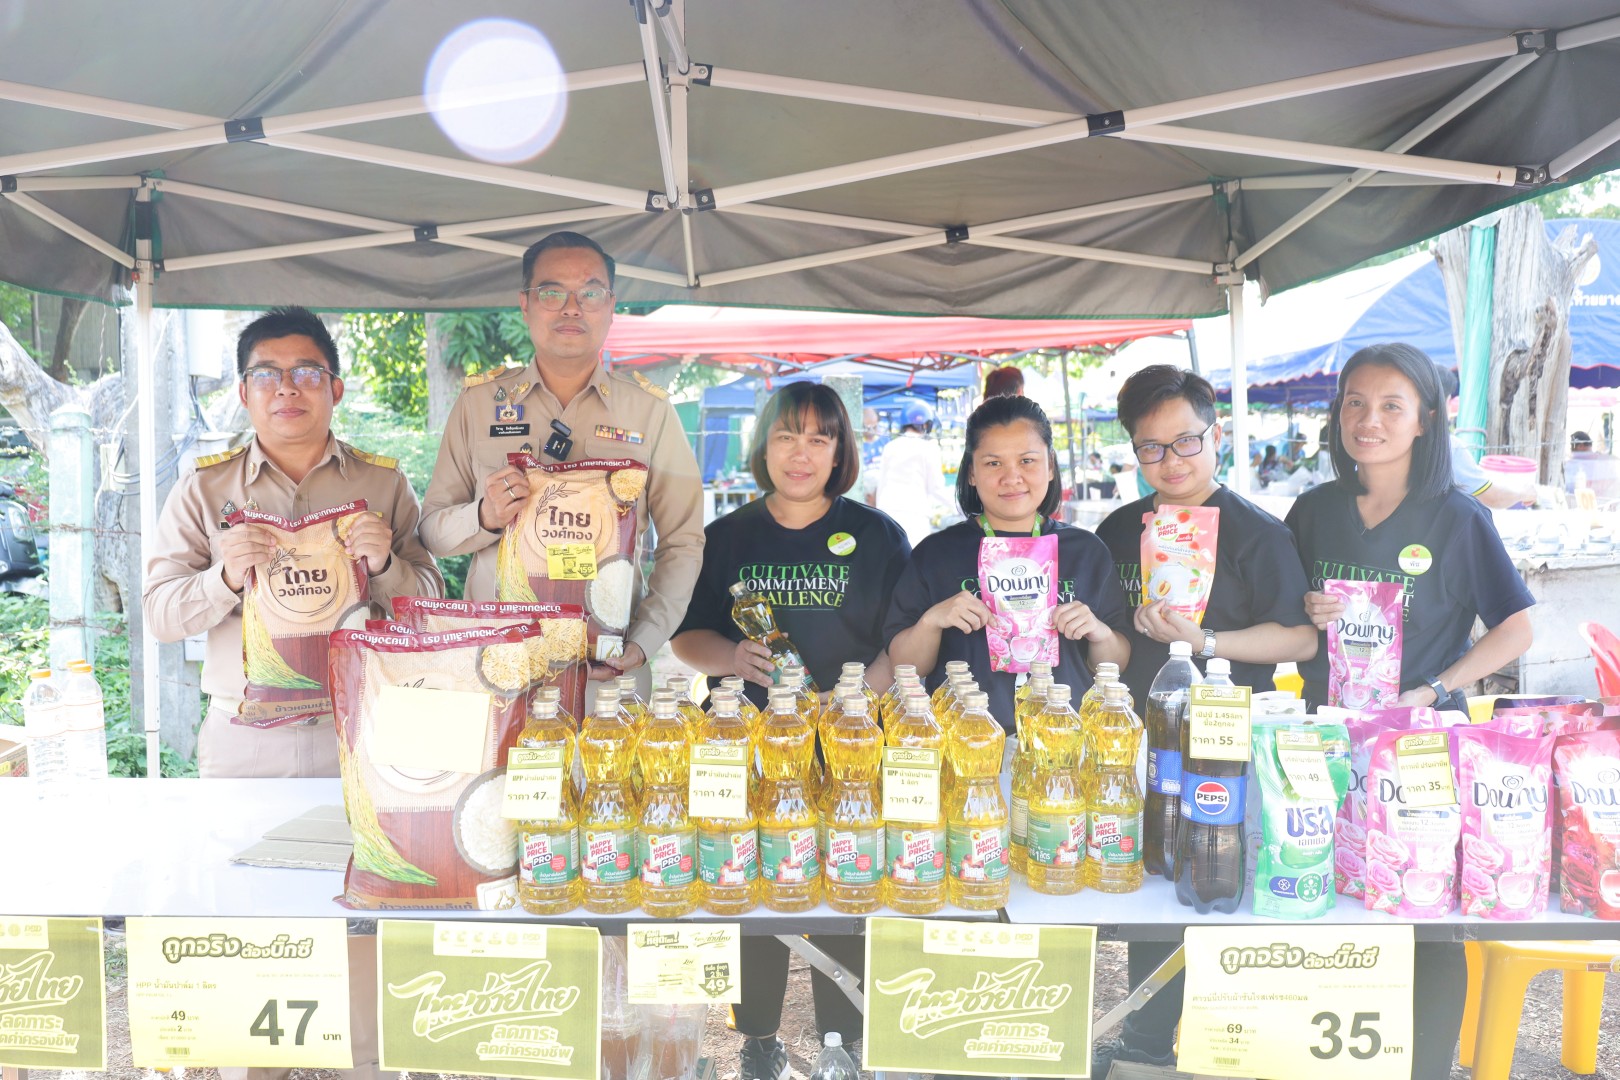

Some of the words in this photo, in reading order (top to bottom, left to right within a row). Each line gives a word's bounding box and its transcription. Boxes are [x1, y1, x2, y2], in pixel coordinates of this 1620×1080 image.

[304, 502, 355, 523] ข้าวหอมมะลิแท้
[548, 506, 591, 526] ไทย
[541, 527, 593, 541] วงศ์ทอง
[1158, 523, 1178, 532] HAPPY
[1158, 528, 1178, 538] PRICE
[282, 567, 328, 585] ไทย
[739, 564, 850, 581] CULTIVATE
[278, 584, 332, 597] วงศ์ทอง
[747, 577, 849, 594] OMMITMENT
[987, 575, 1049, 594] Downy
[766, 591, 843, 607] ALLENGE
[415, 600, 468, 613] ไทยวงศ์ทอง
[500, 604, 561, 615] ข้าวหอมมะลิแท้
[351, 631, 409, 646] ไทยวงศ์ทอง
[423, 636, 440, 644] ตรา
[443, 628, 499, 645] วหอมมะลิแท้
[1219, 736, 1233, 745] 55
[1308, 773, 1320, 782] 49
[1429, 781, 1441, 791] 35
[533, 791, 547, 800] 47
[693, 790, 715, 798] ราคา
[718, 788, 732, 798] 47
[889, 796, 909, 804] ราคา
[912, 795, 925, 804] 47
[1196, 792, 1228, 803] PEPSI
[1474, 782, 1548, 812] Downy
[1095, 822, 1116, 830] HAPPY
[1286, 805, 1333, 838] บรีส
[1096, 828, 1117, 838] PRICE
[525, 841, 546, 851] HAPPY
[590, 840, 612, 851] HAPPY
[831, 839, 852, 849] HAPPY
[907, 838, 930, 850] HAPPY
[975, 835, 997, 848] HAPPY
[1102, 834, 1121, 846] PRO
[526, 847, 548, 858] PRICE
[591, 845, 613, 856] PRICE
[653, 842, 675, 854] HAPPY
[654, 847, 677, 860] PRICE
[832, 845, 853, 855] PRICE
[909, 844, 931, 857] PRICE
[977, 840, 999, 855] PRICE
[533, 854, 553, 865] PRO
[598, 853, 617, 865] PRO
[662, 855, 681, 868] PRO
[838, 852, 857, 863] PRO
[916, 851, 935, 864] PRO
[985, 847, 1002, 863] PRO
[706, 978, 727, 992] 49
[171, 1010, 186, 1021] 49
[2, 1016, 62, 1030] ลดภาระ
[249, 999, 319, 1047] 47
[323, 1032, 342, 1042] บาท
[1227, 1023, 1243, 1034] 69
[492, 1027, 557, 1043] ลดภาระ
[983, 1023, 1048, 1039] ลดภาระ
[1309, 1011, 1382, 1060] 35
[1384, 1044, 1404, 1055] บาท
[478, 1041, 572, 1058] ลดค่าครองชีพ
[966, 1039, 1062, 1056] ลดค่าครองชีพ
